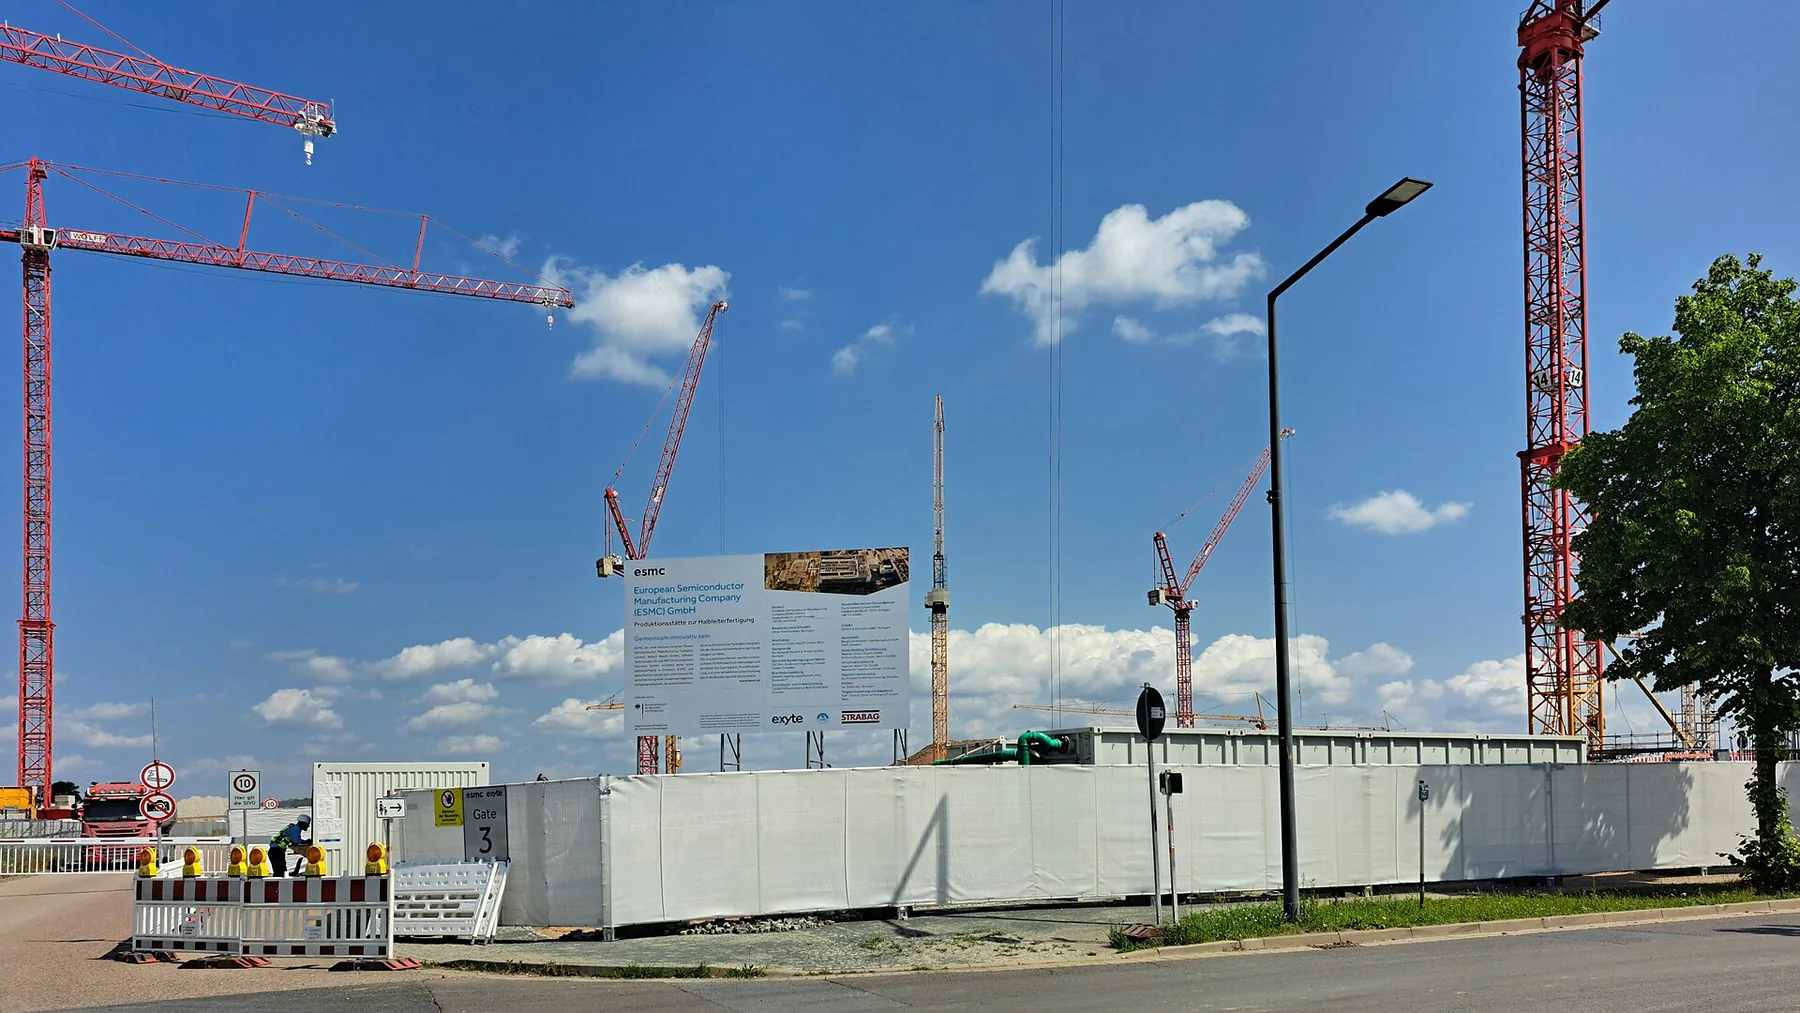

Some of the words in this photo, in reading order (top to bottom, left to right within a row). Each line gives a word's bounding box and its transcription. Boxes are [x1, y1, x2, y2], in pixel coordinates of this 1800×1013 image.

[1534, 373, 1548, 385] 14
[1572, 370, 1581, 384] 14
[634, 567, 665, 576] esmc
[634, 587, 675, 595] European
[677, 583, 744, 592] Semiconductor
[634, 596, 697, 605] Manufacturing
[698, 594, 741, 603] Company
[634, 607, 665, 617] (ESMC)
[667, 606, 696, 615] GmbH
[634, 619, 687, 627] Produktionsstätte
[698, 617, 755, 625] Halbleiterfertigung
[772, 713, 803, 725] exyte
[841, 713, 880, 721] STRABAG
[239, 779, 251, 788] 10
[486, 790, 503, 798] exyte
[473, 808, 497, 820] Gate
[479, 826, 492, 854] 3
